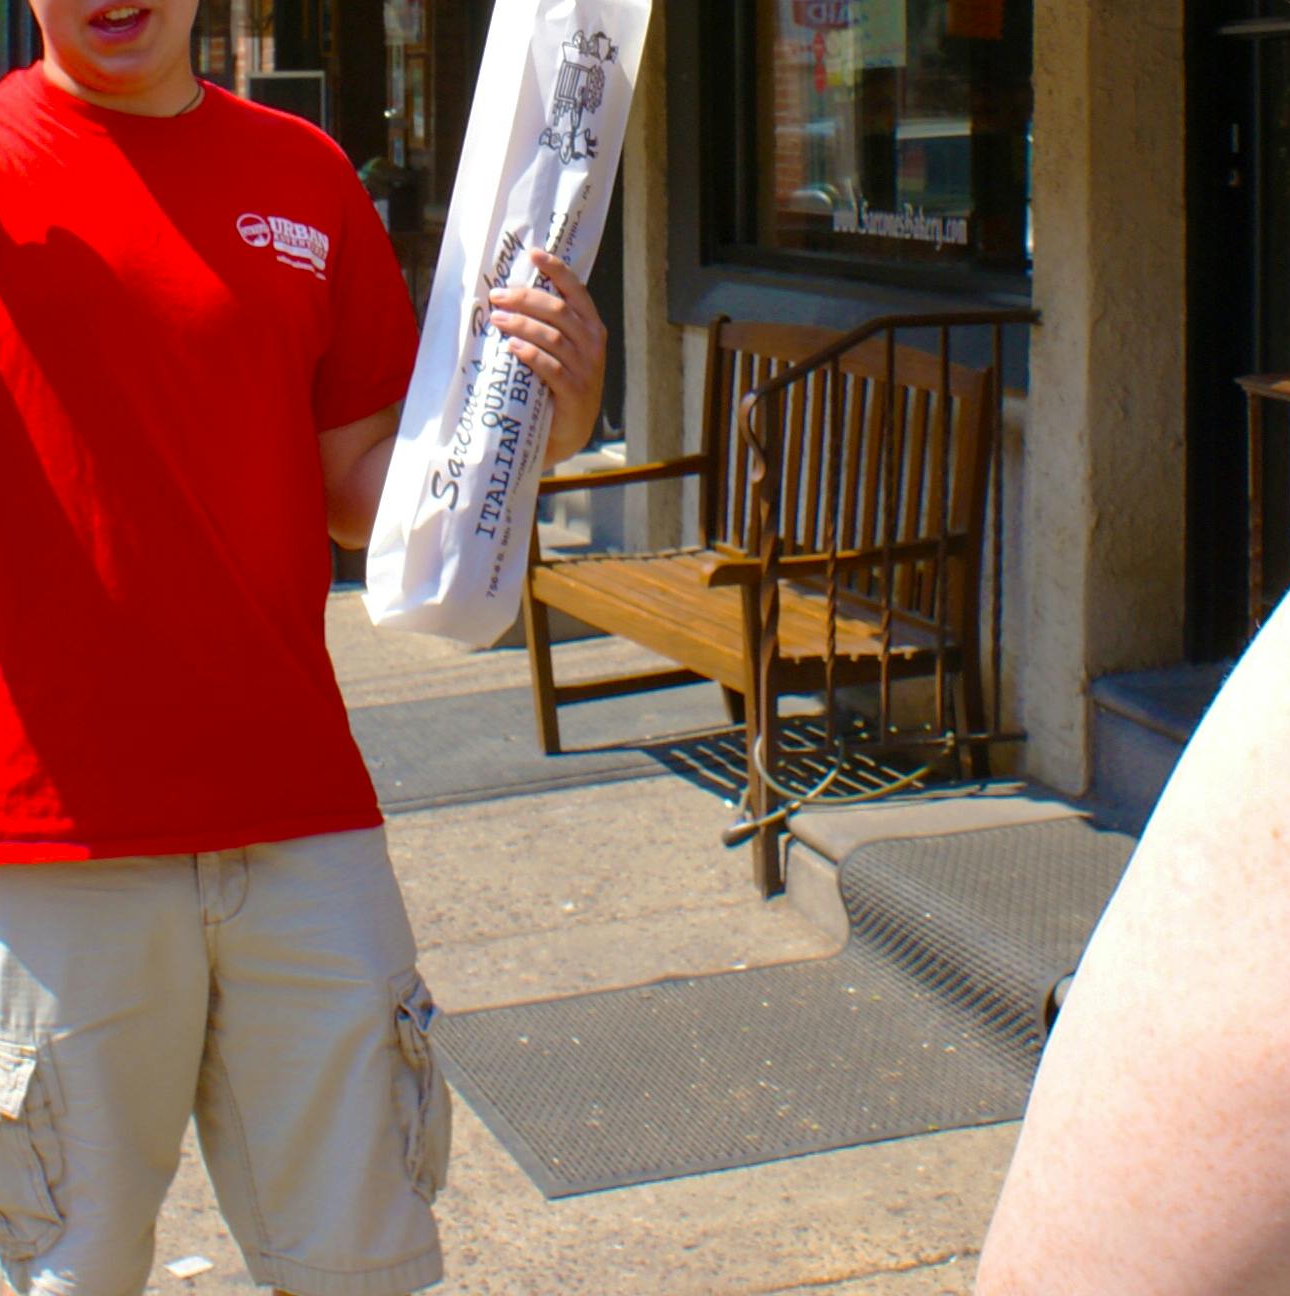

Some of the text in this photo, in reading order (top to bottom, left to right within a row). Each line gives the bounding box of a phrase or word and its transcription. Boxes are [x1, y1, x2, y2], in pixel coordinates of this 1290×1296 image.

[267, 215, 330, 251] URBAN
[431, 358, 487, 511] Sarcone's
[472, 230, 526, 338] Bkery
[481, 331, 514, 429] QUALI
[475, 413, 522, 540] ITALIAN
